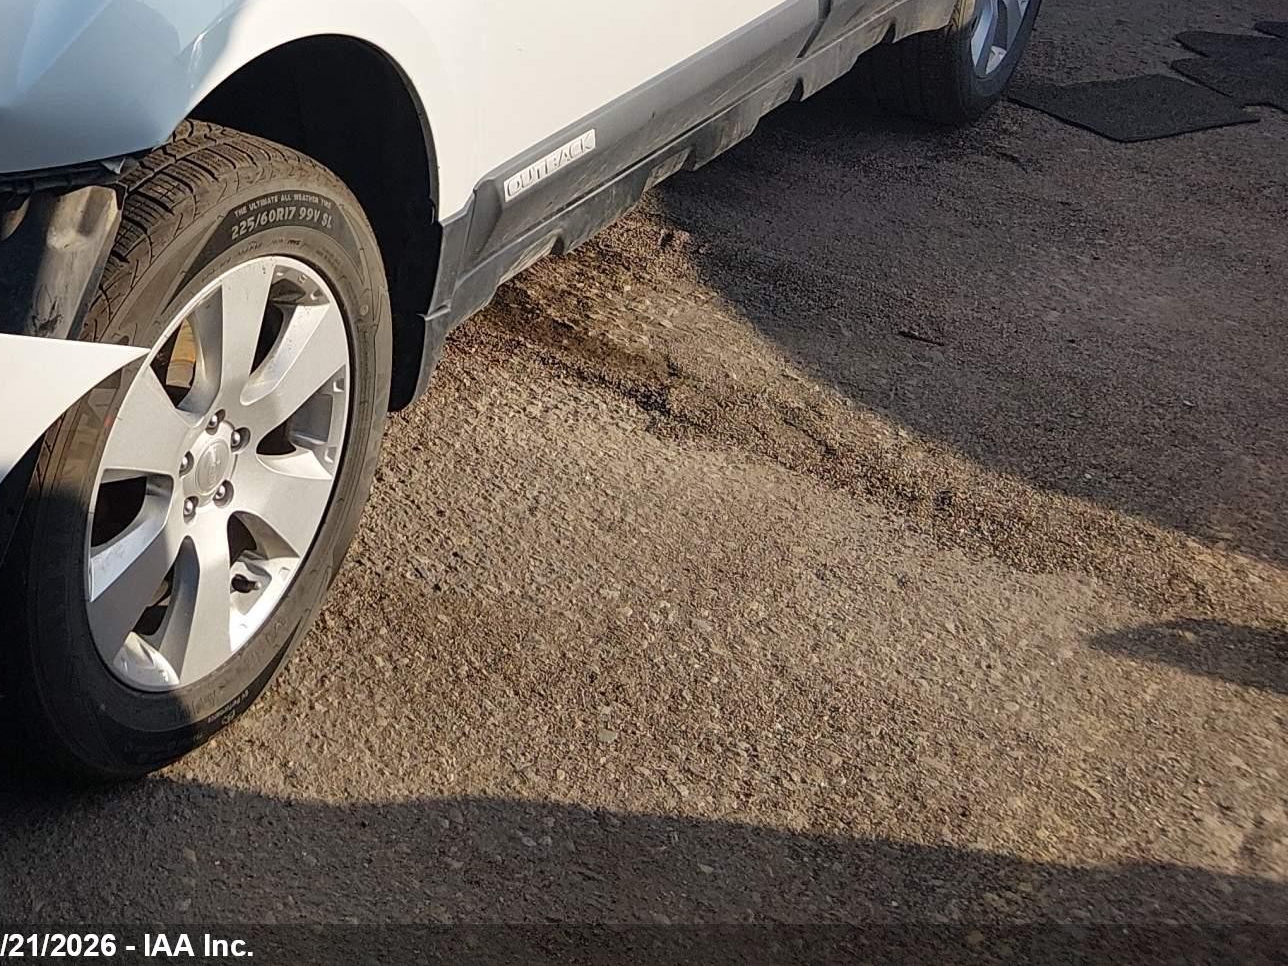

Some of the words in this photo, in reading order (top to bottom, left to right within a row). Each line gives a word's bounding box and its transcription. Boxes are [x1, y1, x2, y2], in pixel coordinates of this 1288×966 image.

[234, 206, 248, 218] THE
[249, 195, 279, 211] ULTIMATE
[281, 194, 292, 202] ALL
[294, 193, 319, 204] WEATHER
[232, 206, 296, 240] 225/60R17
[299, 207, 321, 223] 99V
[321, 212, 333, 229] SL
